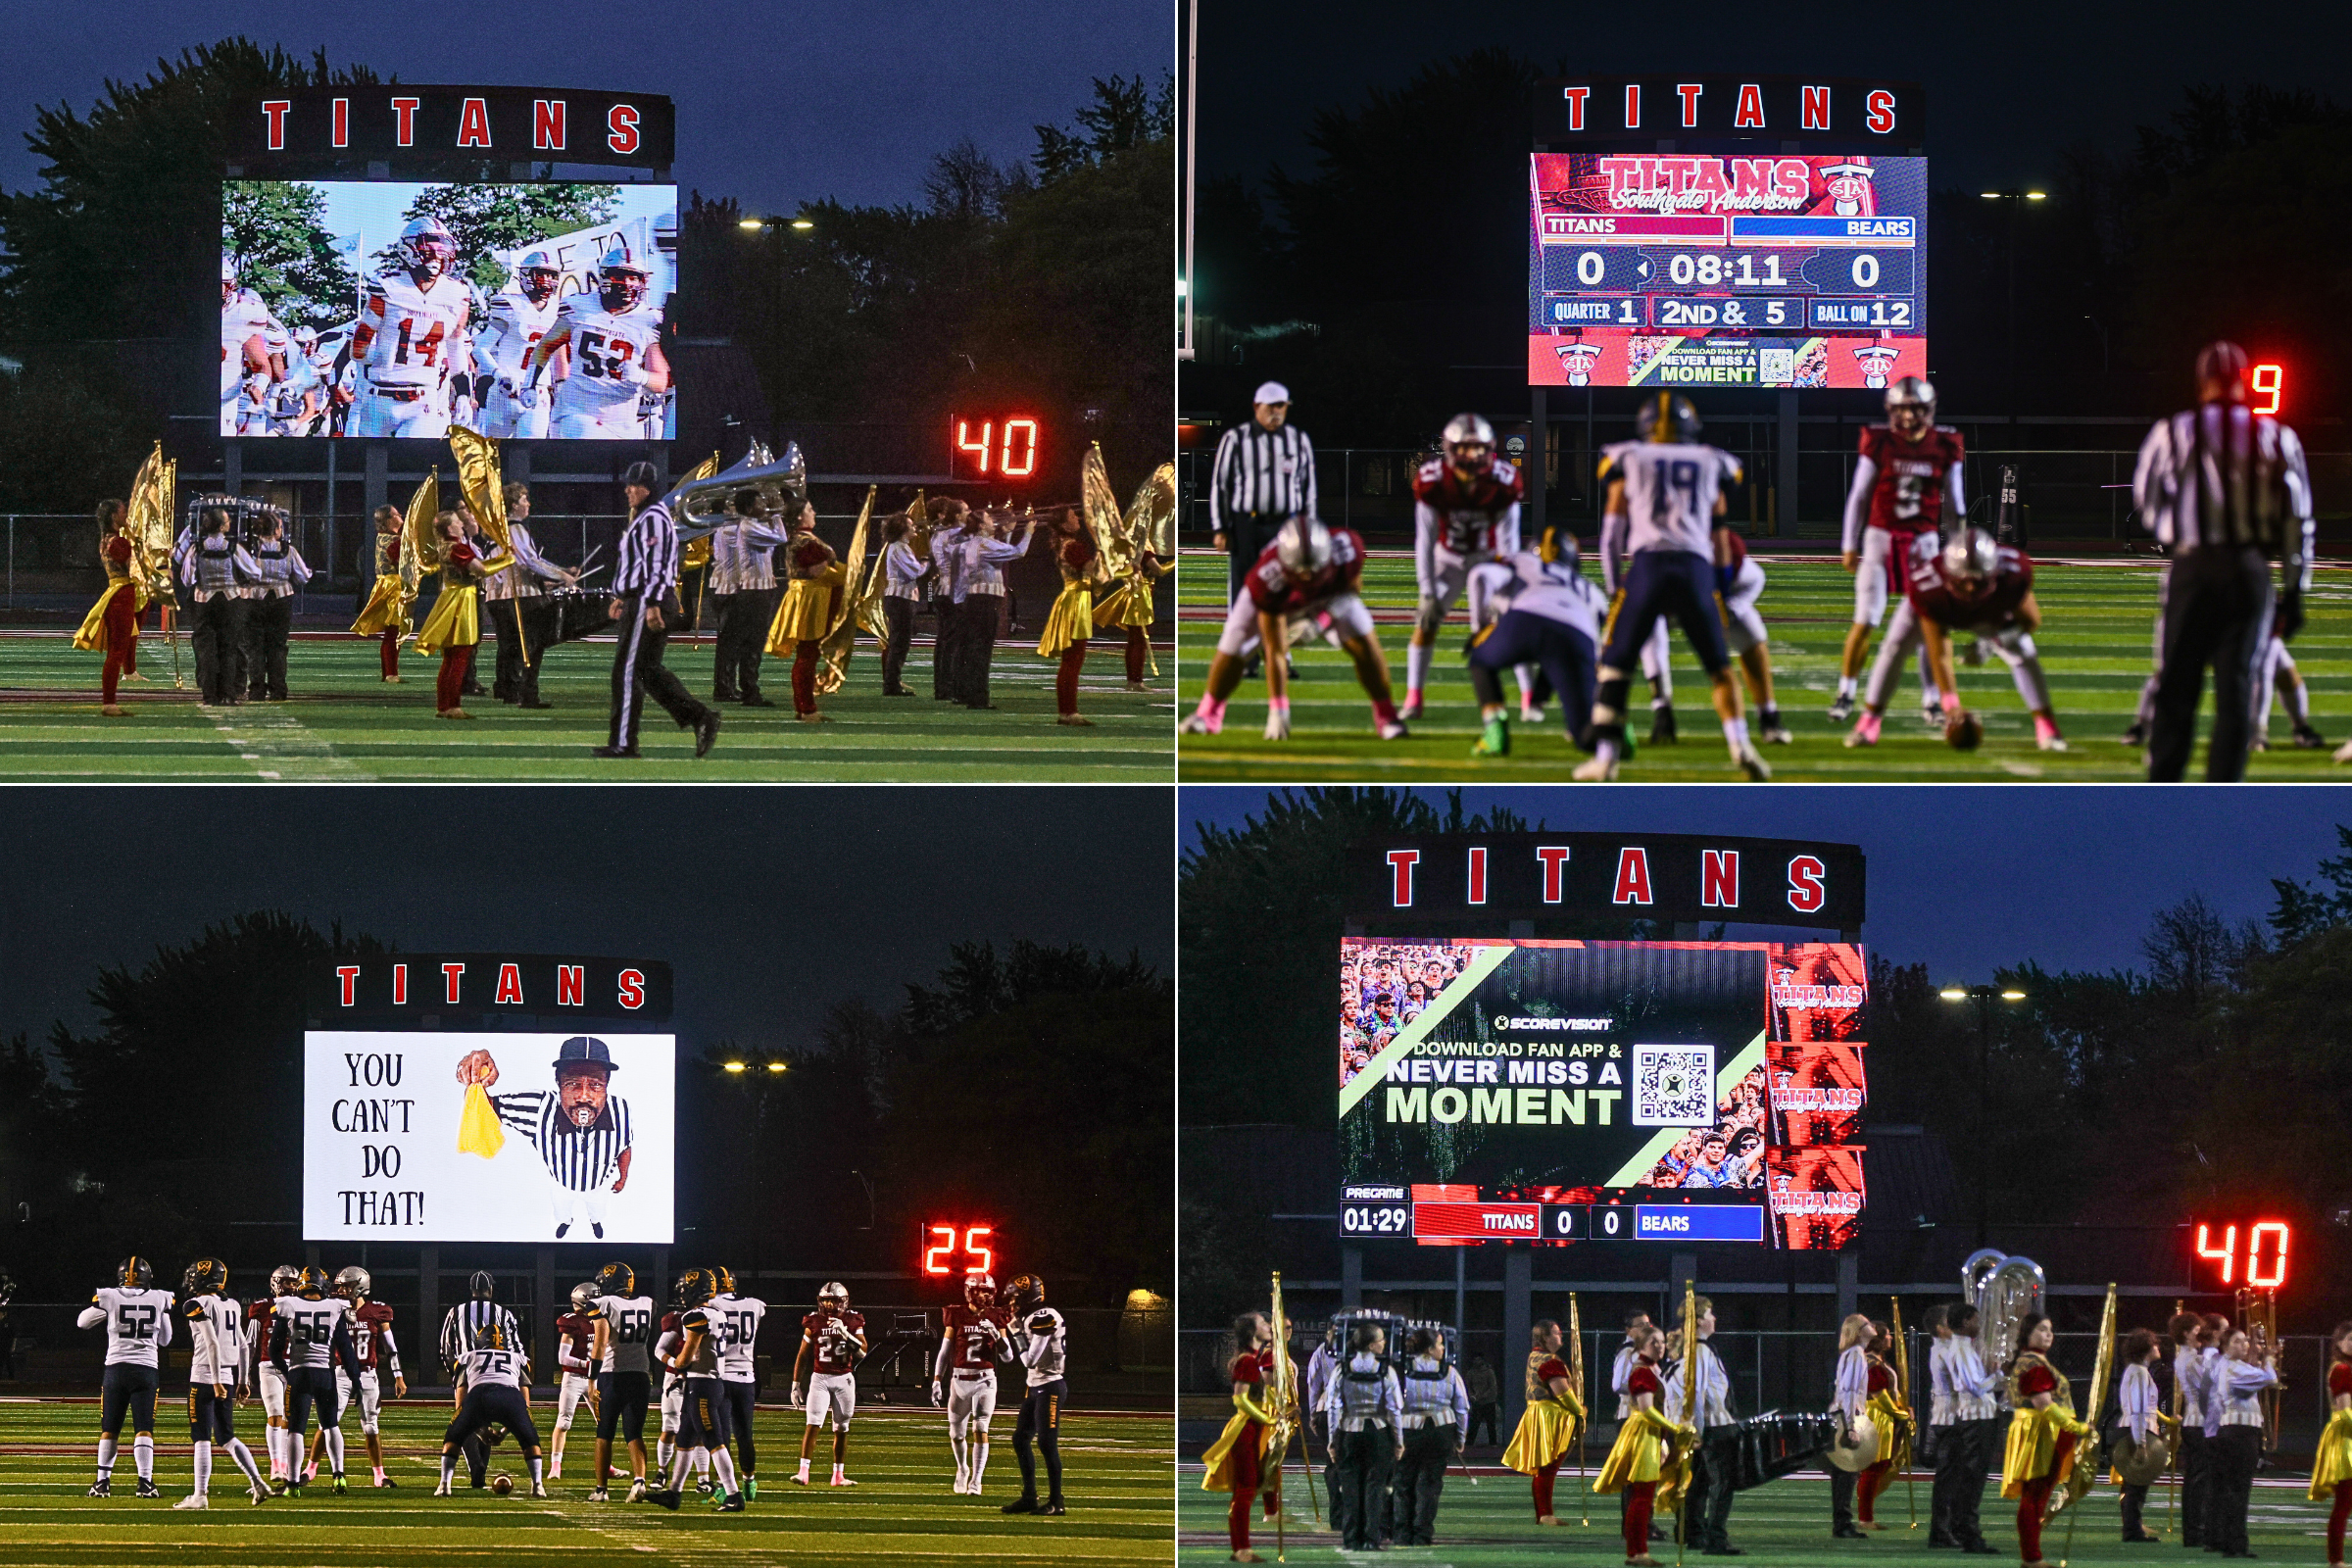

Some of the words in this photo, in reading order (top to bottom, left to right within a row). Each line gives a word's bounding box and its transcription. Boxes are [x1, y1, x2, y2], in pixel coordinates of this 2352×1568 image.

[1565, 84, 1895, 133] TITANS
[263, 97, 640, 155] TITANS
[1599, 158, 1810, 203] TITANS
[1611, 186, 1706, 215] Southgate
[1710, 186, 1803, 214] Anderson
[1547, 219, 1616, 233] TITANS
[1846, 220, 1910, 236] BEARS
[1577, 252, 1605, 285] 0
[1669, 254, 1788, 286] 08:11
[1851, 254, 1880, 288] 0
[1554, 303, 1611, 320] QUARTER
[1618, 300, 1639, 323] 1
[1661, 300, 1718, 324] 2ND
[1722, 301, 1747, 325] &
[1765, 301, 1786, 324] 5
[1817, 305, 1849, 322] BALL
[1850, 306, 1868, 322] ON
[1870, 302, 1910, 325] 12
[395, 318, 445, 368] 14
[1661, 355, 1707, 366] NEVER
[1710, 356, 1743, 367] MISS
[1745, 356, 1757, 367] A
[1661, 366, 1757, 382] MOMENT
[956, 418, 1038, 477] 40
[1655, 459, 1699, 515] 19
[2000, 488, 2017, 504] 55
[1386, 846, 1826, 913] TITANS
[336, 963, 645, 1009] TITANS
[1772, 985, 1863, 1004] TITANS
[1413, 1042, 1522, 1057] DOWNLOAD
[1528, 1043, 1564, 1057] FAN
[1569, 1044, 1604, 1058] APP
[1608, 1044, 1623, 1058] &
[344, 1054, 404, 1087] YOU
[1386, 1059, 1499, 1083] NEVER
[1508, 1060, 1590, 1085] MISS
[1597, 1061, 1623, 1085] A
[1386, 1086, 1623, 1126] MOMENT
[1772, 1088, 1862, 1105] TITANS
[331, 1099, 416, 1134] CAN'T
[362, 1145, 402, 1179] DO
[337, 1191, 425, 1227] THAT!
[1346, 1187, 1404, 1200] PREGAME
[1771, 1191, 1861, 1208] TITANS
[1344, 1207, 1406, 1232] 01:29
[1482, 1214, 1535, 1230] TITANS
[1557, 1211, 1572, 1234] 0
[1604, 1211, 1619, 1234] 0
[1642, 1215, 1690, 1232] BEARS
[925, 1227, 993, 1274] 25
[2196, 1222, 2289, 1287] 40
[120, 1304, 156, 1339] 52
[224, 1309, 236, 1347] 4
[294, 1310, 331, 1346] 56
[618, 1309, 651, 1344] 68
[724, 1311, 755, 1345] 50
[475, 1351, 512, 1376] 72
[967, 1334, 983, 1362] 2
